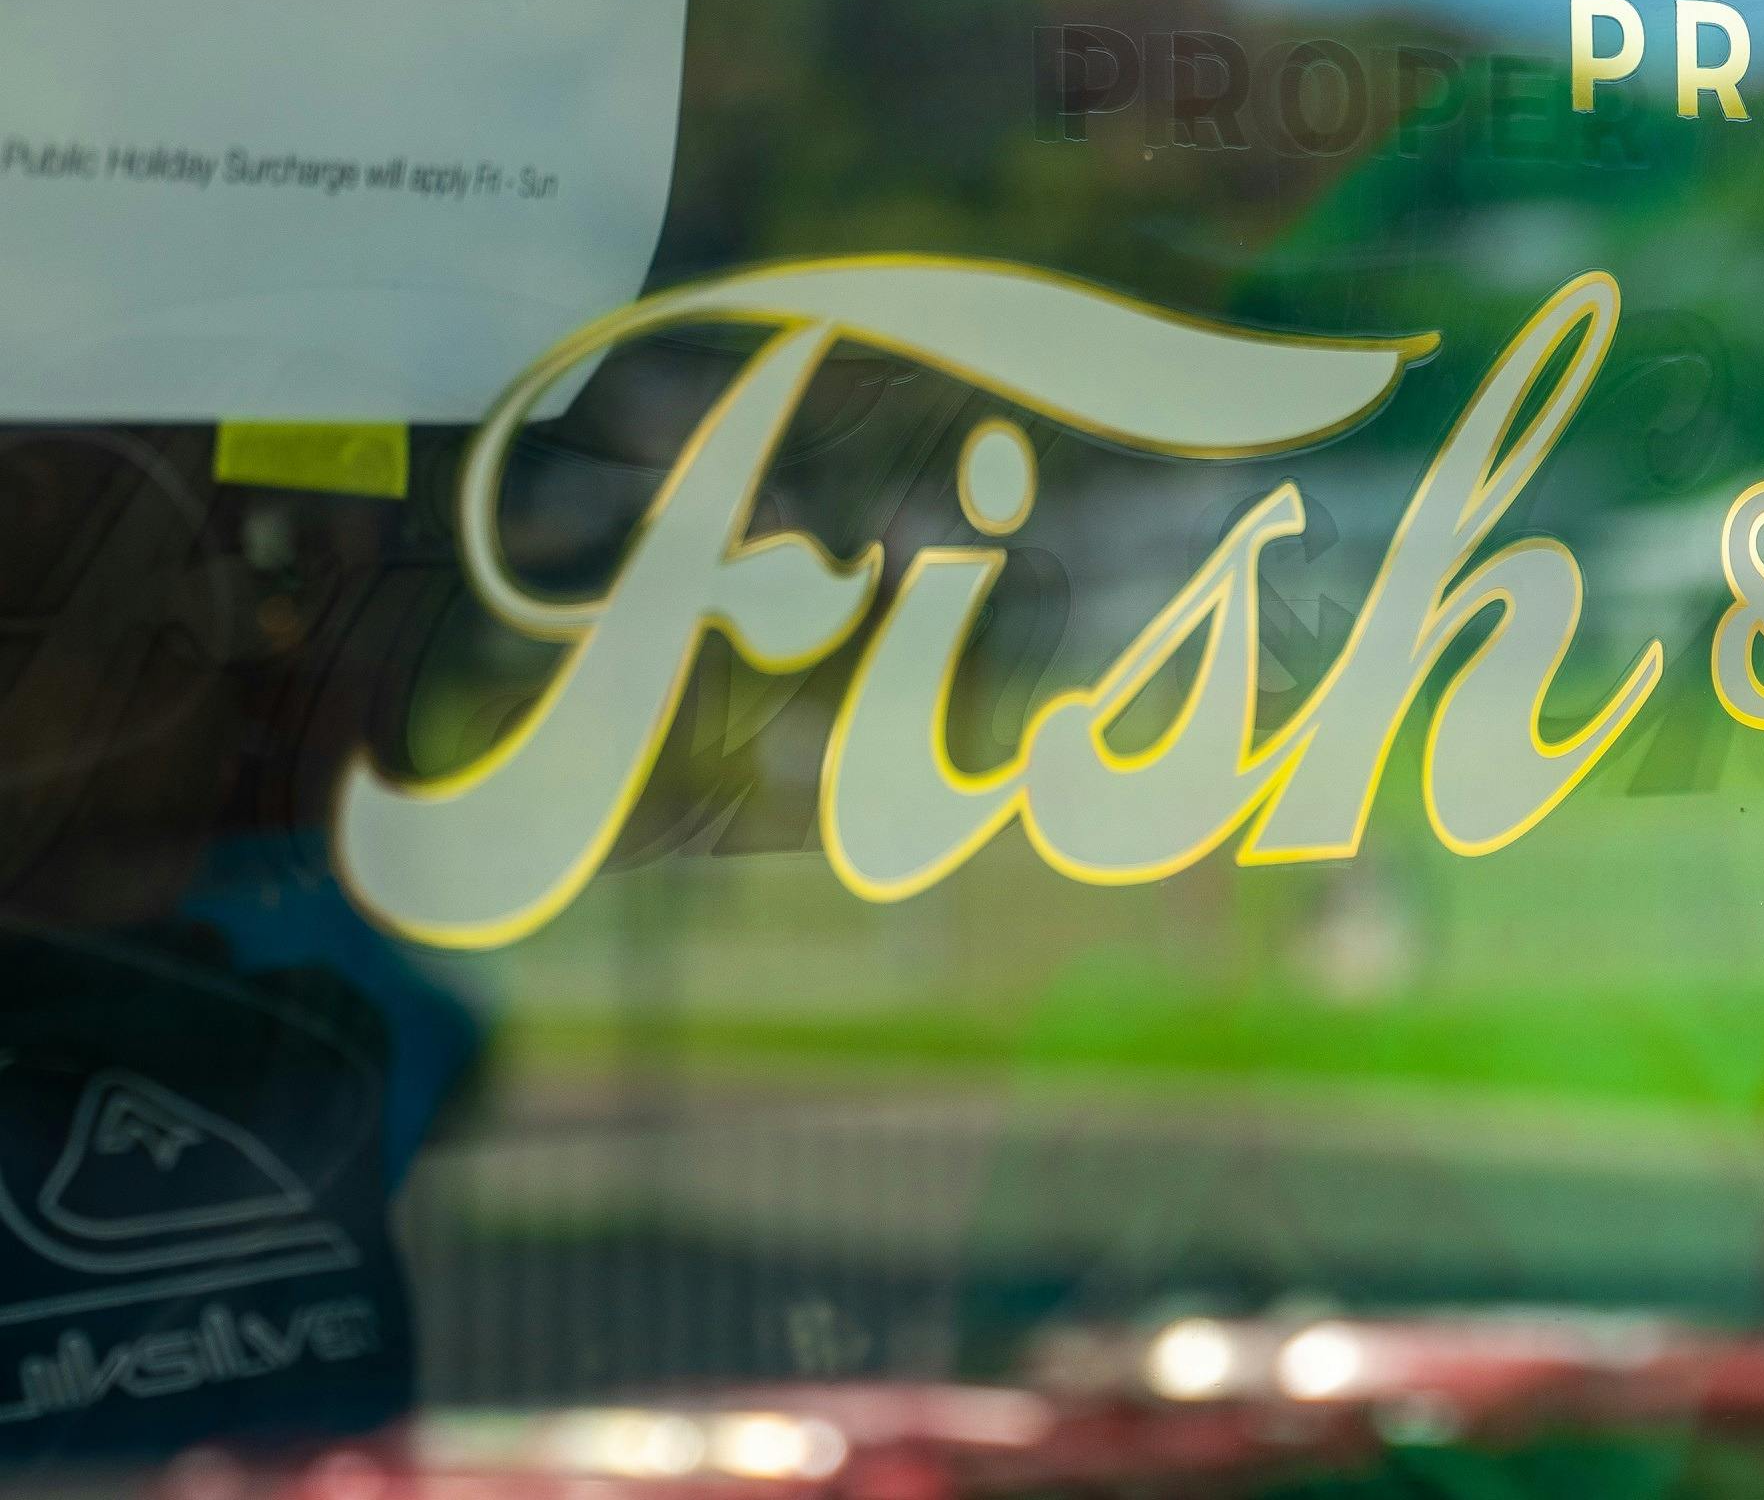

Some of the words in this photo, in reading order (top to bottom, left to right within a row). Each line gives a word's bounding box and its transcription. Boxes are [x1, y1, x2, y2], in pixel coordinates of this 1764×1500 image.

[105, 143, 219, 192] Holiday
[222, 145, 361, 198] Surcharge
[363, 156, 408, 191] will
[408, 163, 473, 203] apply
[516, 164, 560, 201] Sun
[334, 252, 1664, 951] Fish
